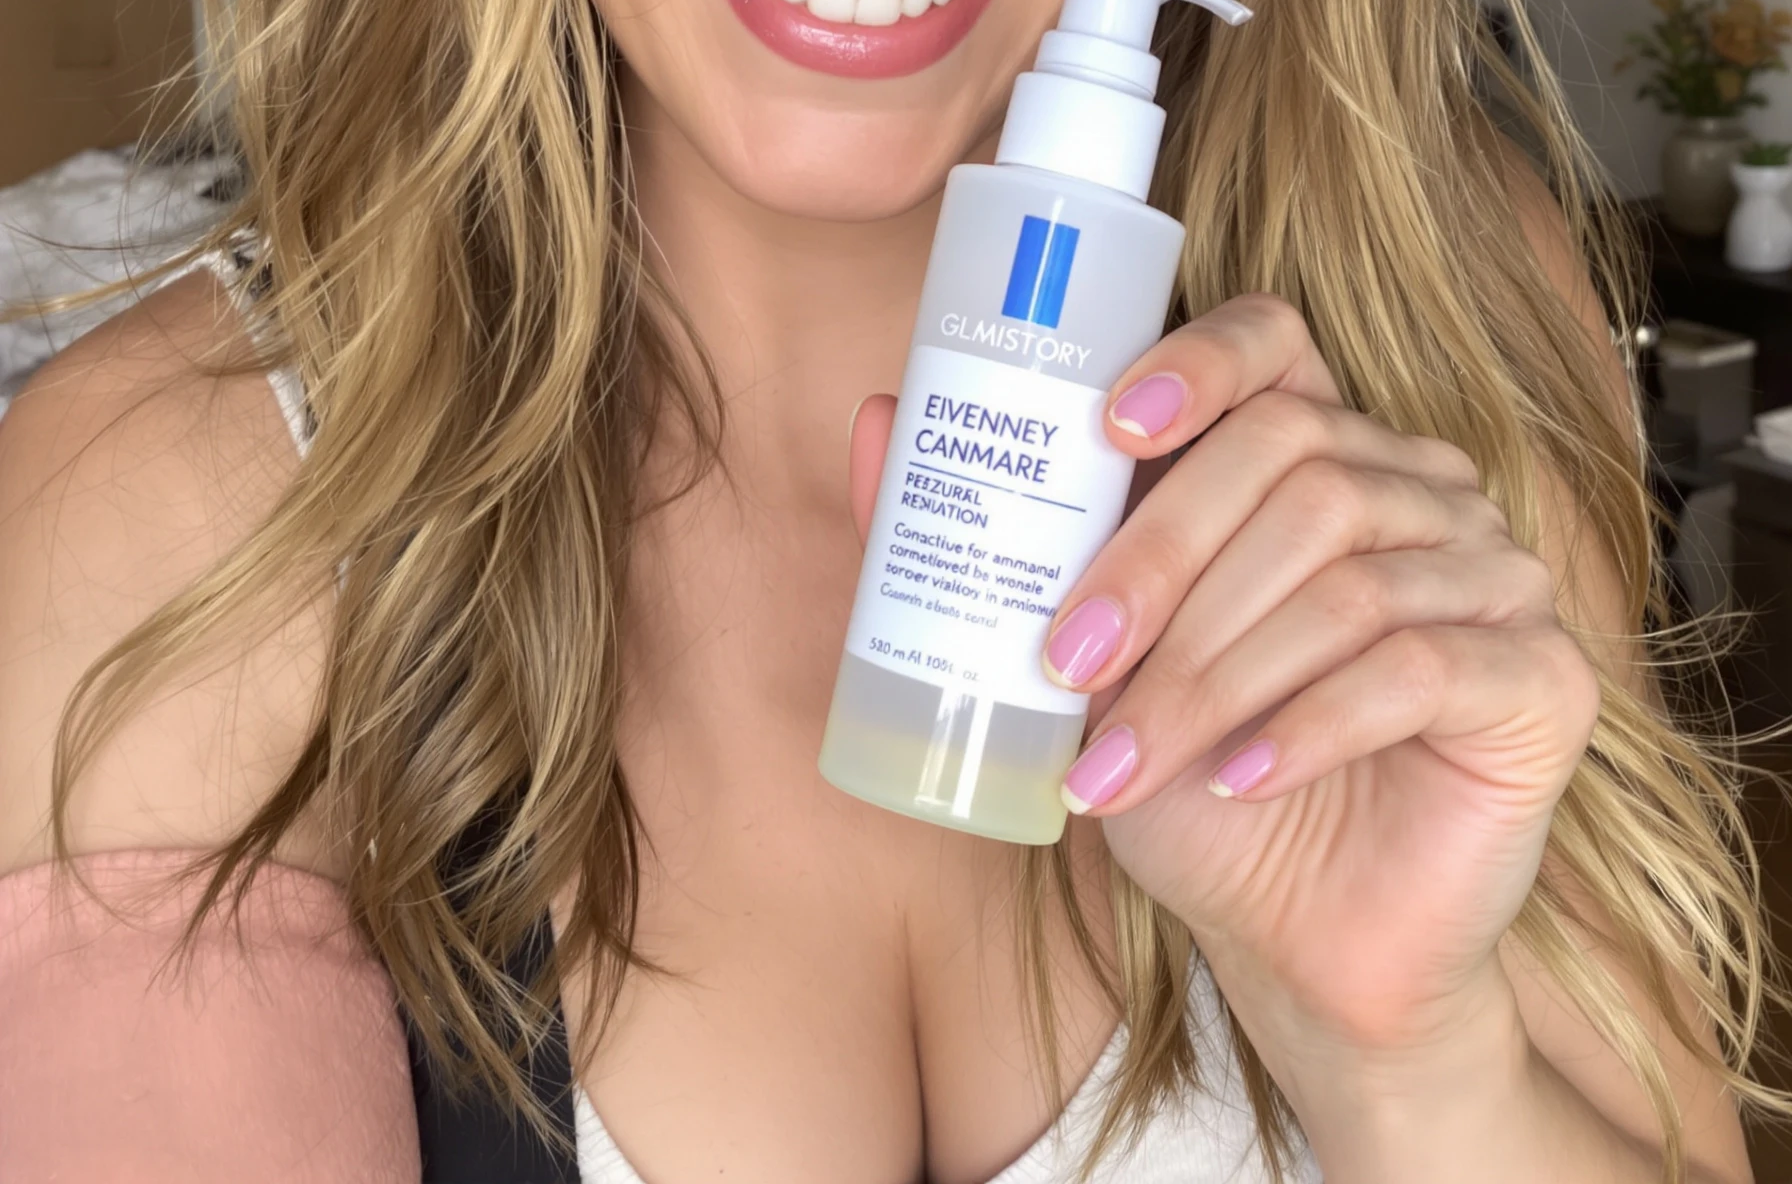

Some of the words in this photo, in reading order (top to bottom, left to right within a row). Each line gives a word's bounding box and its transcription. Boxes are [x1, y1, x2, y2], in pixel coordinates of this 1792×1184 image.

[940, 312, 1092, 369] GLMISTORY
[924, 394, 1059, 447] EIVENNEY
[915, 429, 1050, 483] CANMARE
[967, 542, 988, 560] for
